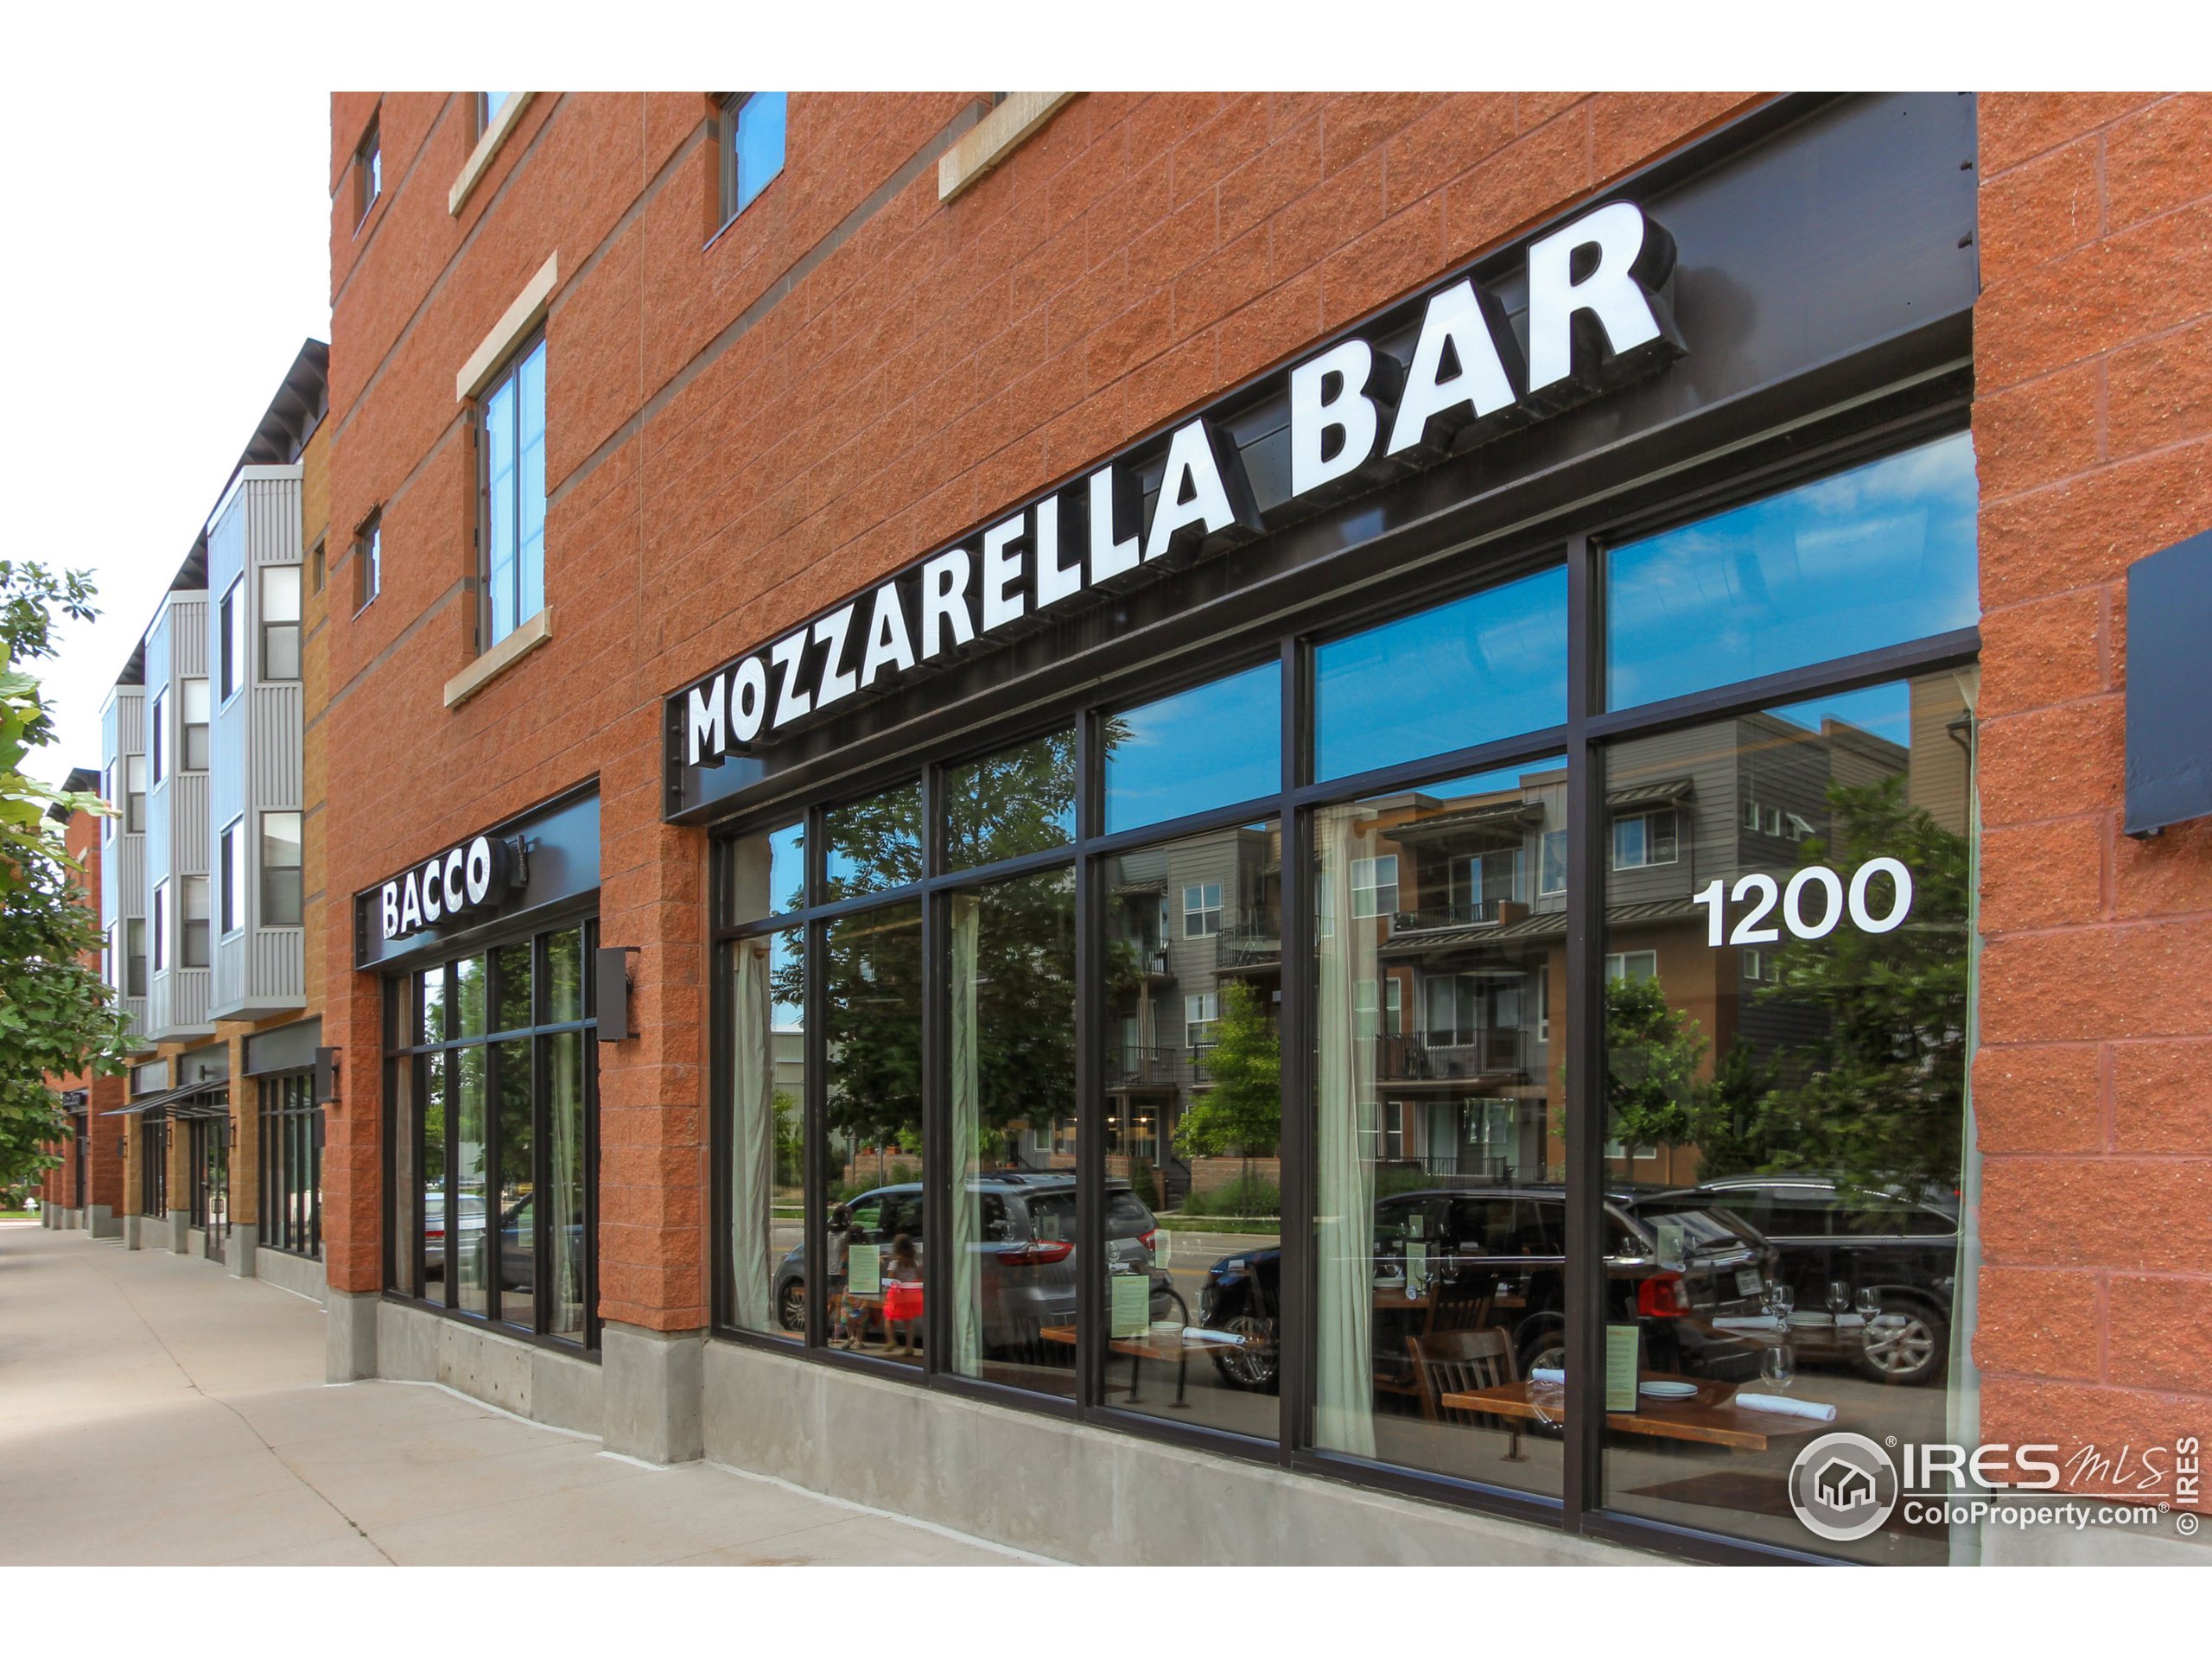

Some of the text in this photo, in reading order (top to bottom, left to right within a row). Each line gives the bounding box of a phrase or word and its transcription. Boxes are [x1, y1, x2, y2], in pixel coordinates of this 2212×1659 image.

[688, 200, 1664, 766] MOZZARELLA BAR
[380, 835, 492, 941] BACCO
[1693, 856, 1912, 947] 1200
